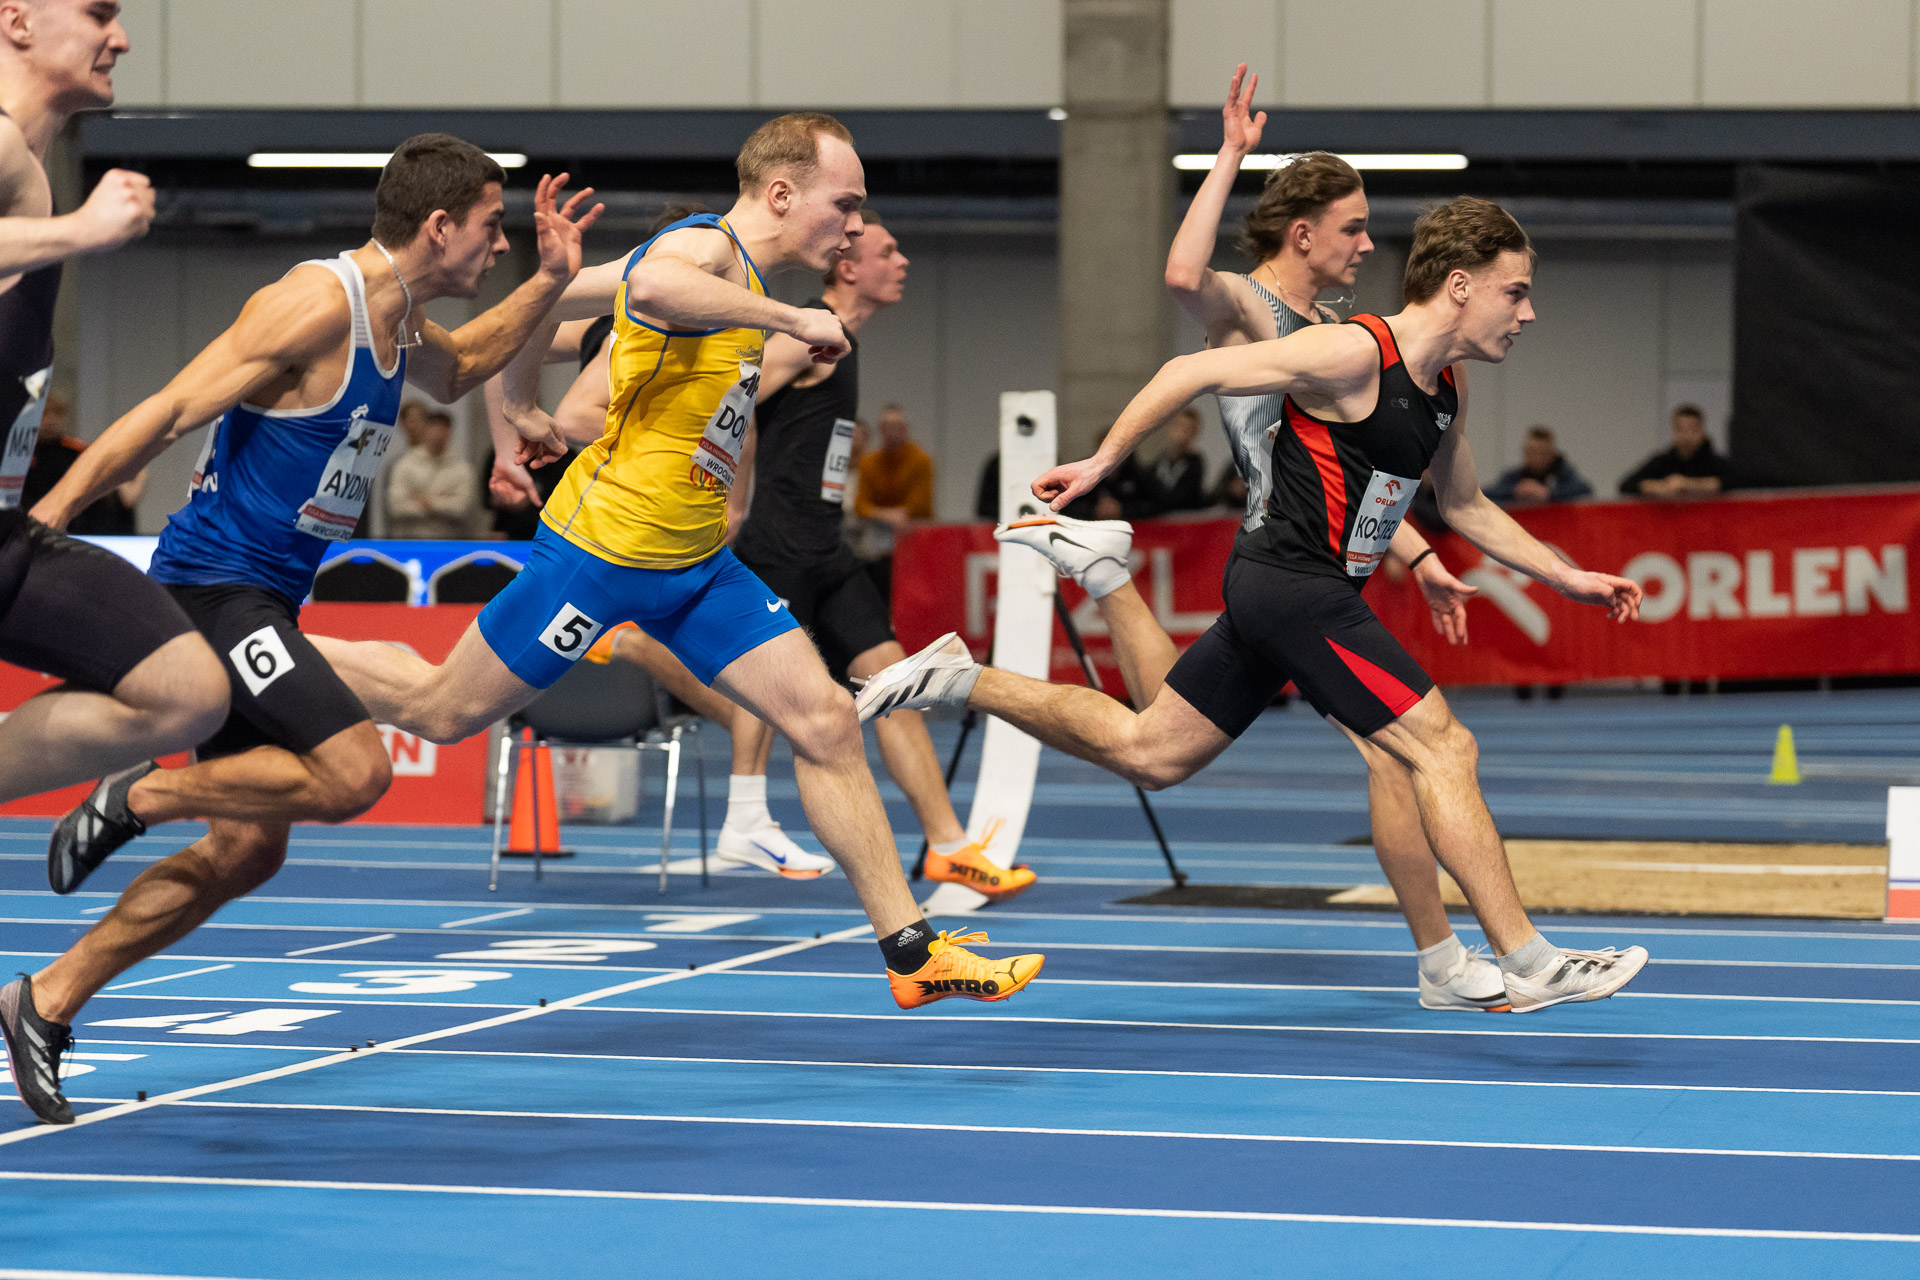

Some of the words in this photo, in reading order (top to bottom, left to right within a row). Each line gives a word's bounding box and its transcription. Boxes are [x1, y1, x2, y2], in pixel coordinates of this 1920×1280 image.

[1618, 543, 1909, 624] ORLEN
[553, 614, 594, 653] 5
[244, 638, 277, 680] 6
[948, 861, 1001, 886] NITRO
[434, 938, 658, 963] 2
[896, 929, 925, 948] adidas
[288, 969, 514, 996] 3
[913, 978, 1000, 998] NITRO
[82, 1007, 343, 1036] 4
